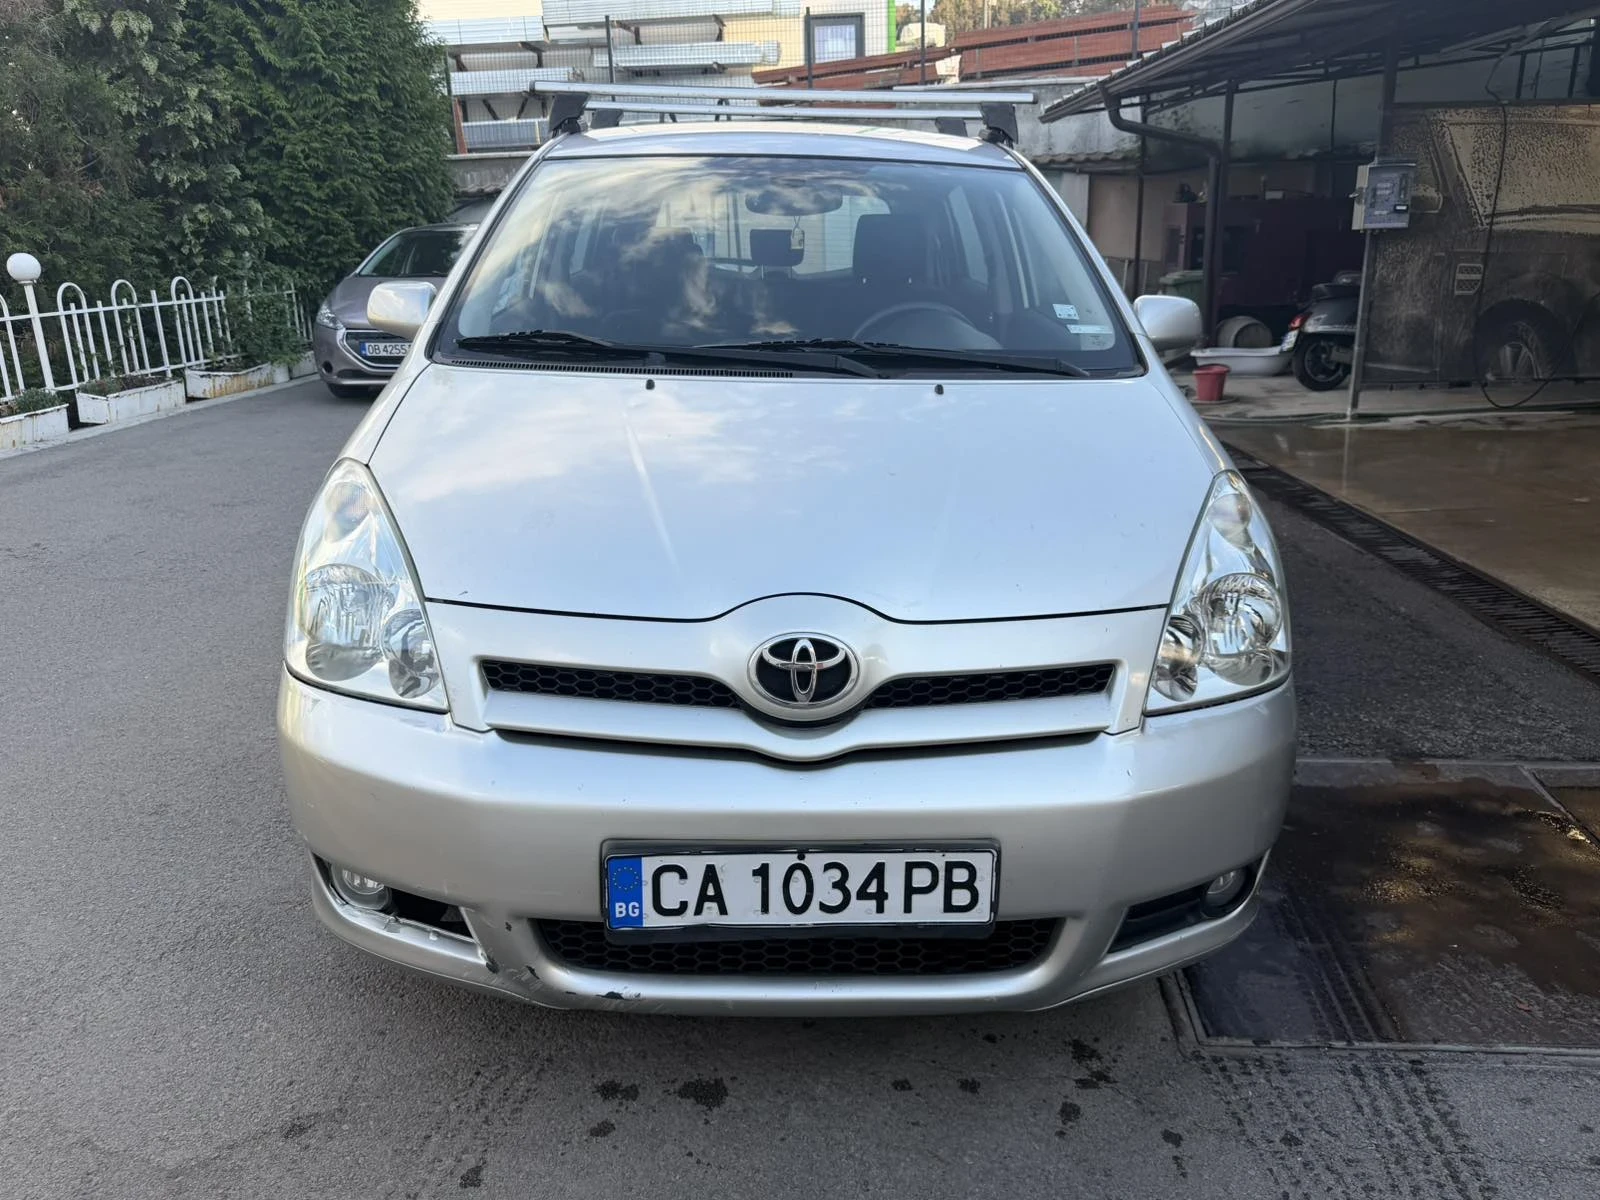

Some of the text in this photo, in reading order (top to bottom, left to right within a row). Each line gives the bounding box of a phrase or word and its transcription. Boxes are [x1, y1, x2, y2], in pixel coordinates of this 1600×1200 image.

[651, 860, 980, 917] CA 1034 PB
[615, 901, 640, 918] BG
